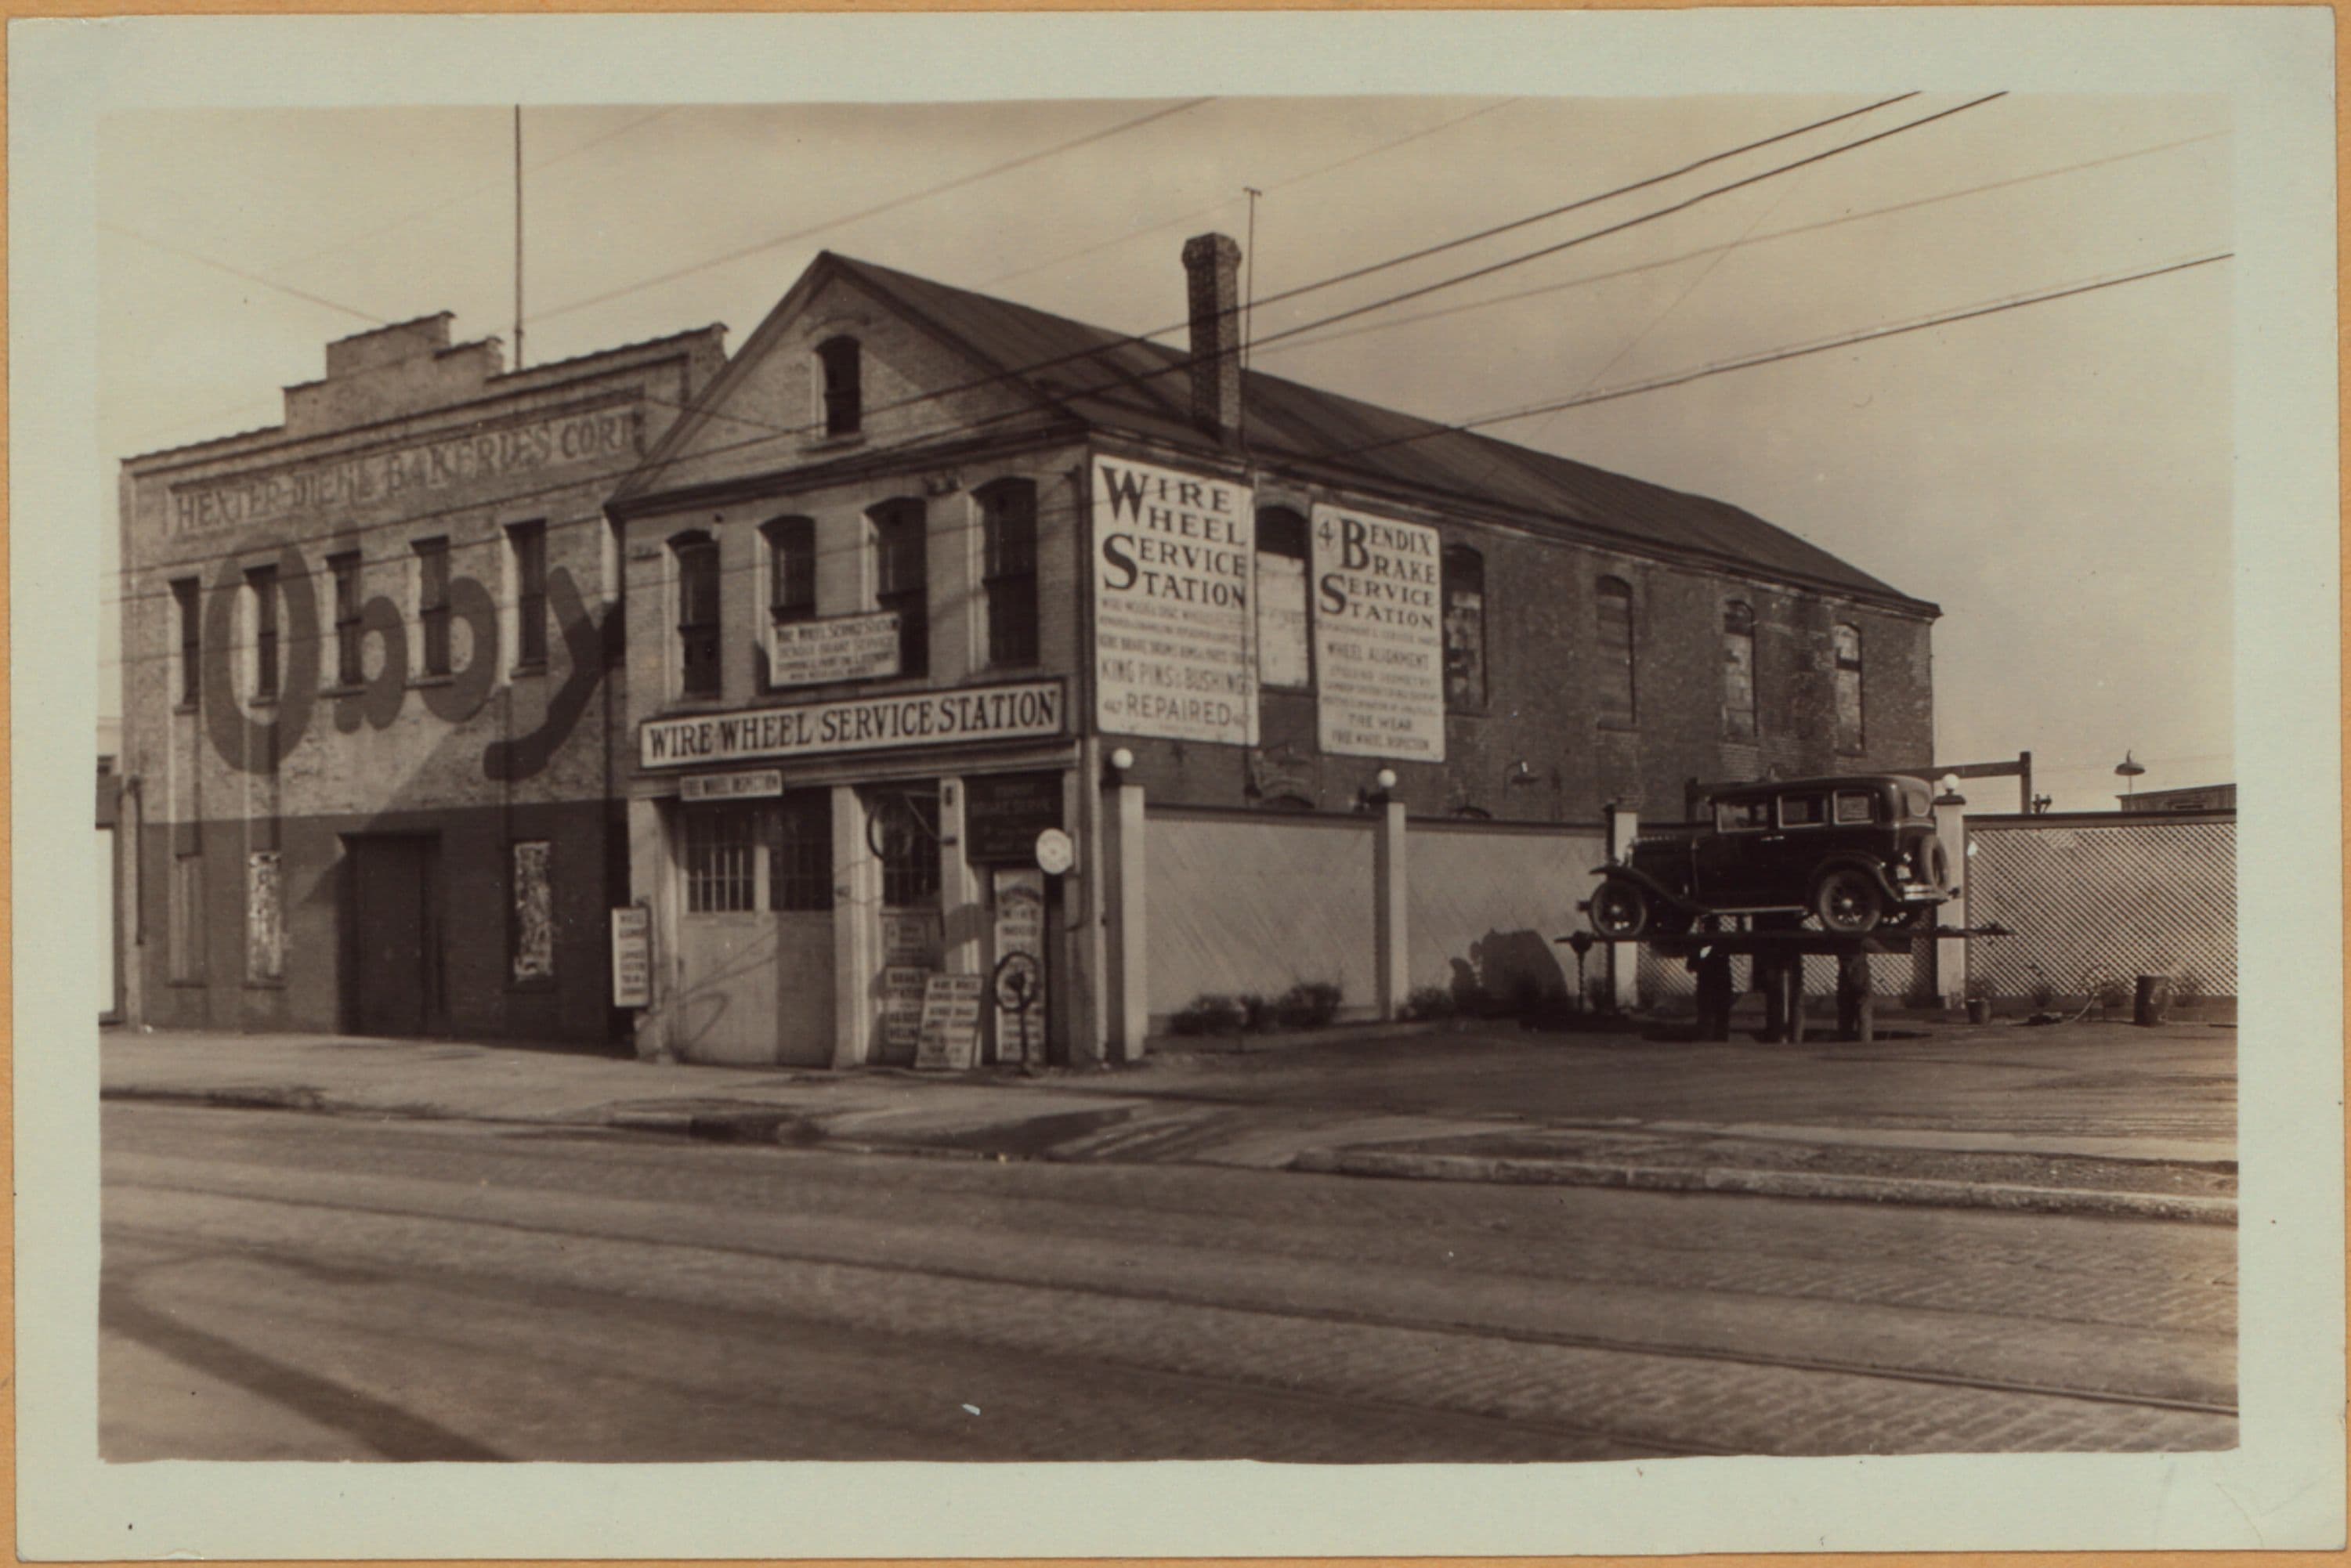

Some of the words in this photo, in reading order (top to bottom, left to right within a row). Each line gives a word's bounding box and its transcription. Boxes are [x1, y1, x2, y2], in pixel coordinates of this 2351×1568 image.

[386, 424, 552, 494] BAKERIES
[1101, 466, 1232, 523] WIRE
[1102, 534, 1246, 591] SERVICE
[1339, 518, 1433, 569] BENDIX
[1319, 573, 1434, 616] SERVICE
[650, 723, 713, 760] WIRE
[717, 710, 812, 752] WHEEL
[820, 700, 932, 742] SERVICE
[938, 688, 1057, 733] STATION
[1127, 693, 1232, 727] REPAIRED
